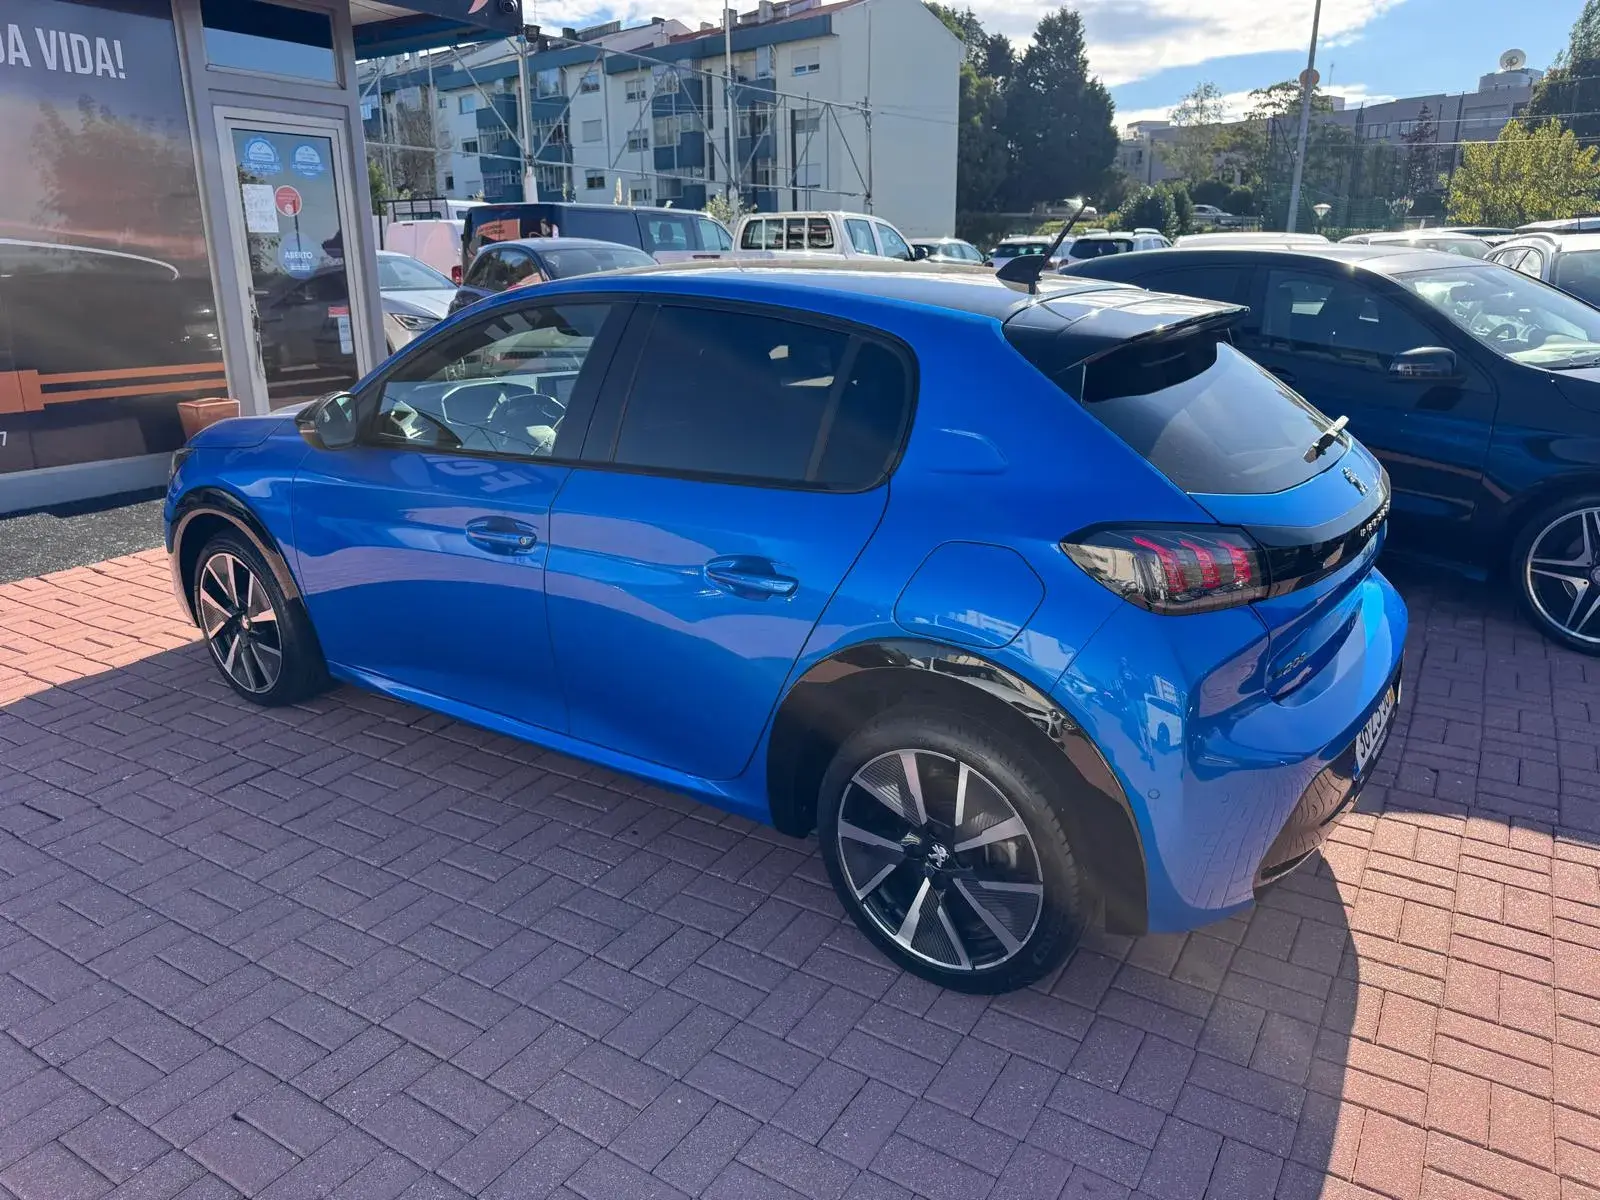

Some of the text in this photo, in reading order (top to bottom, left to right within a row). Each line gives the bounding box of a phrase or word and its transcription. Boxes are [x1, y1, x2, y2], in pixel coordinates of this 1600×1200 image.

[0, 23, 126, 79] A VIDA!
[284, 251, 313, 260] ABERTO
